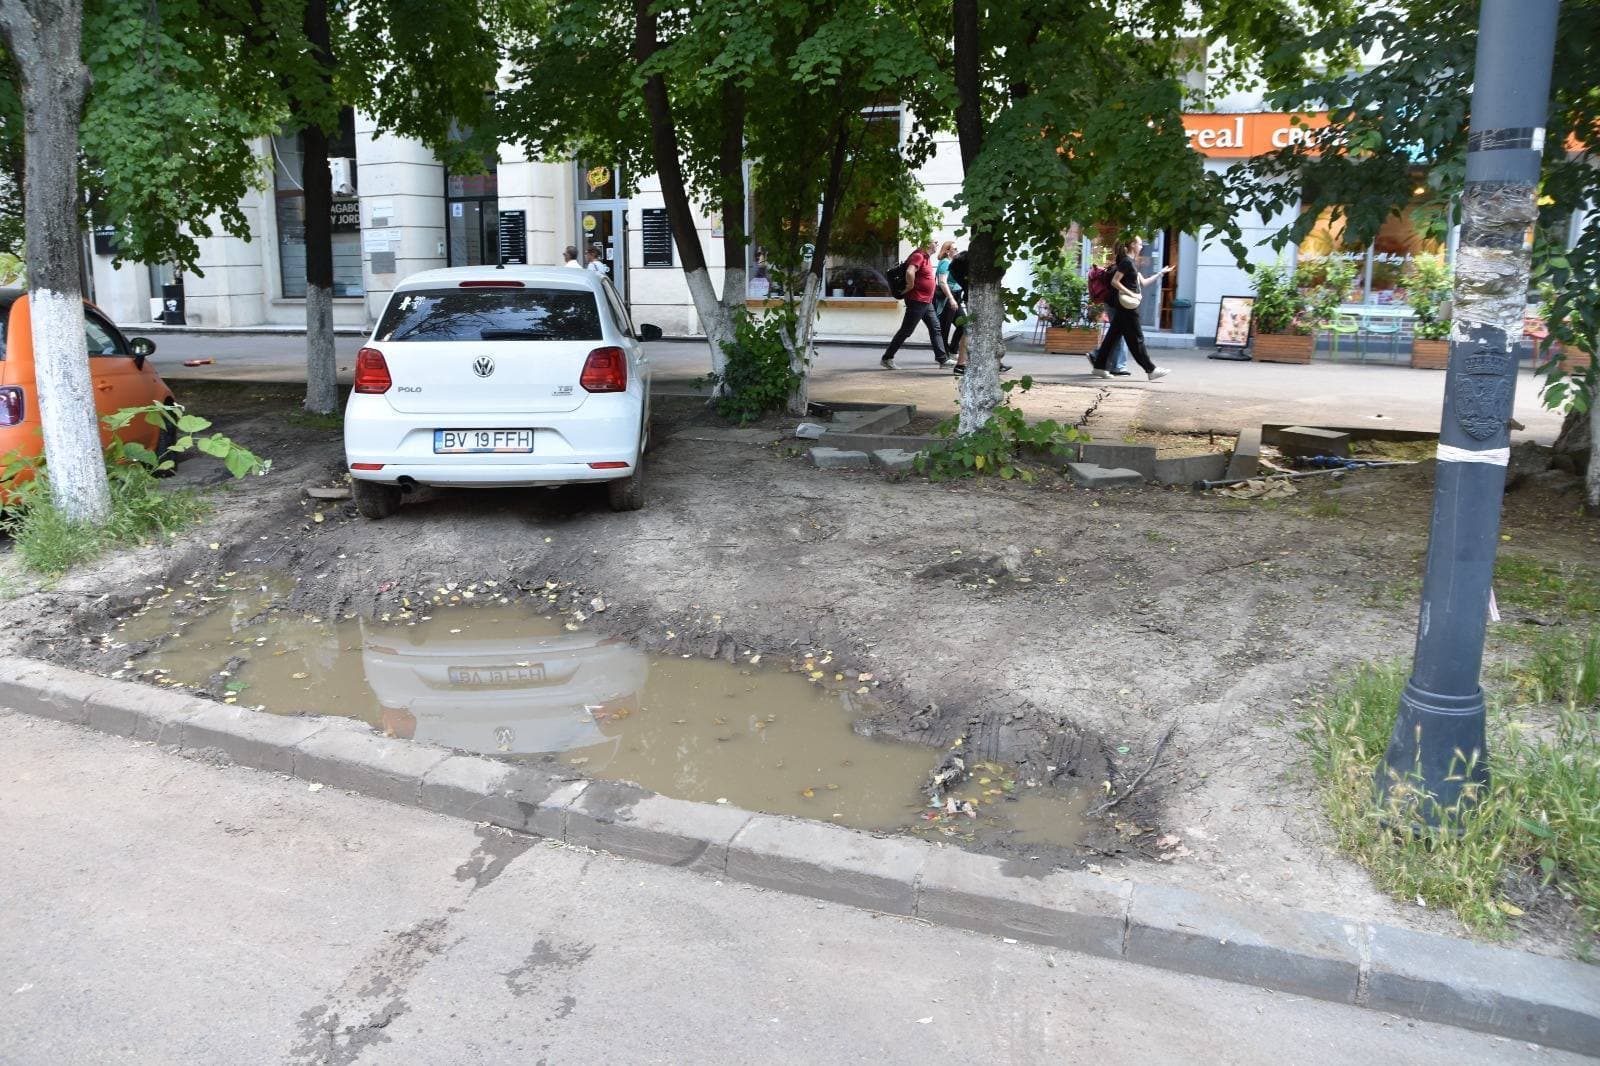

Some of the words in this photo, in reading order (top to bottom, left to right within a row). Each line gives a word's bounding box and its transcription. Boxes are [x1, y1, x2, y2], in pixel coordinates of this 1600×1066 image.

[444, 432, 467, 448] BV
[474, 432, 490, 447] 19
[493, 431, 529, 447] FFH
